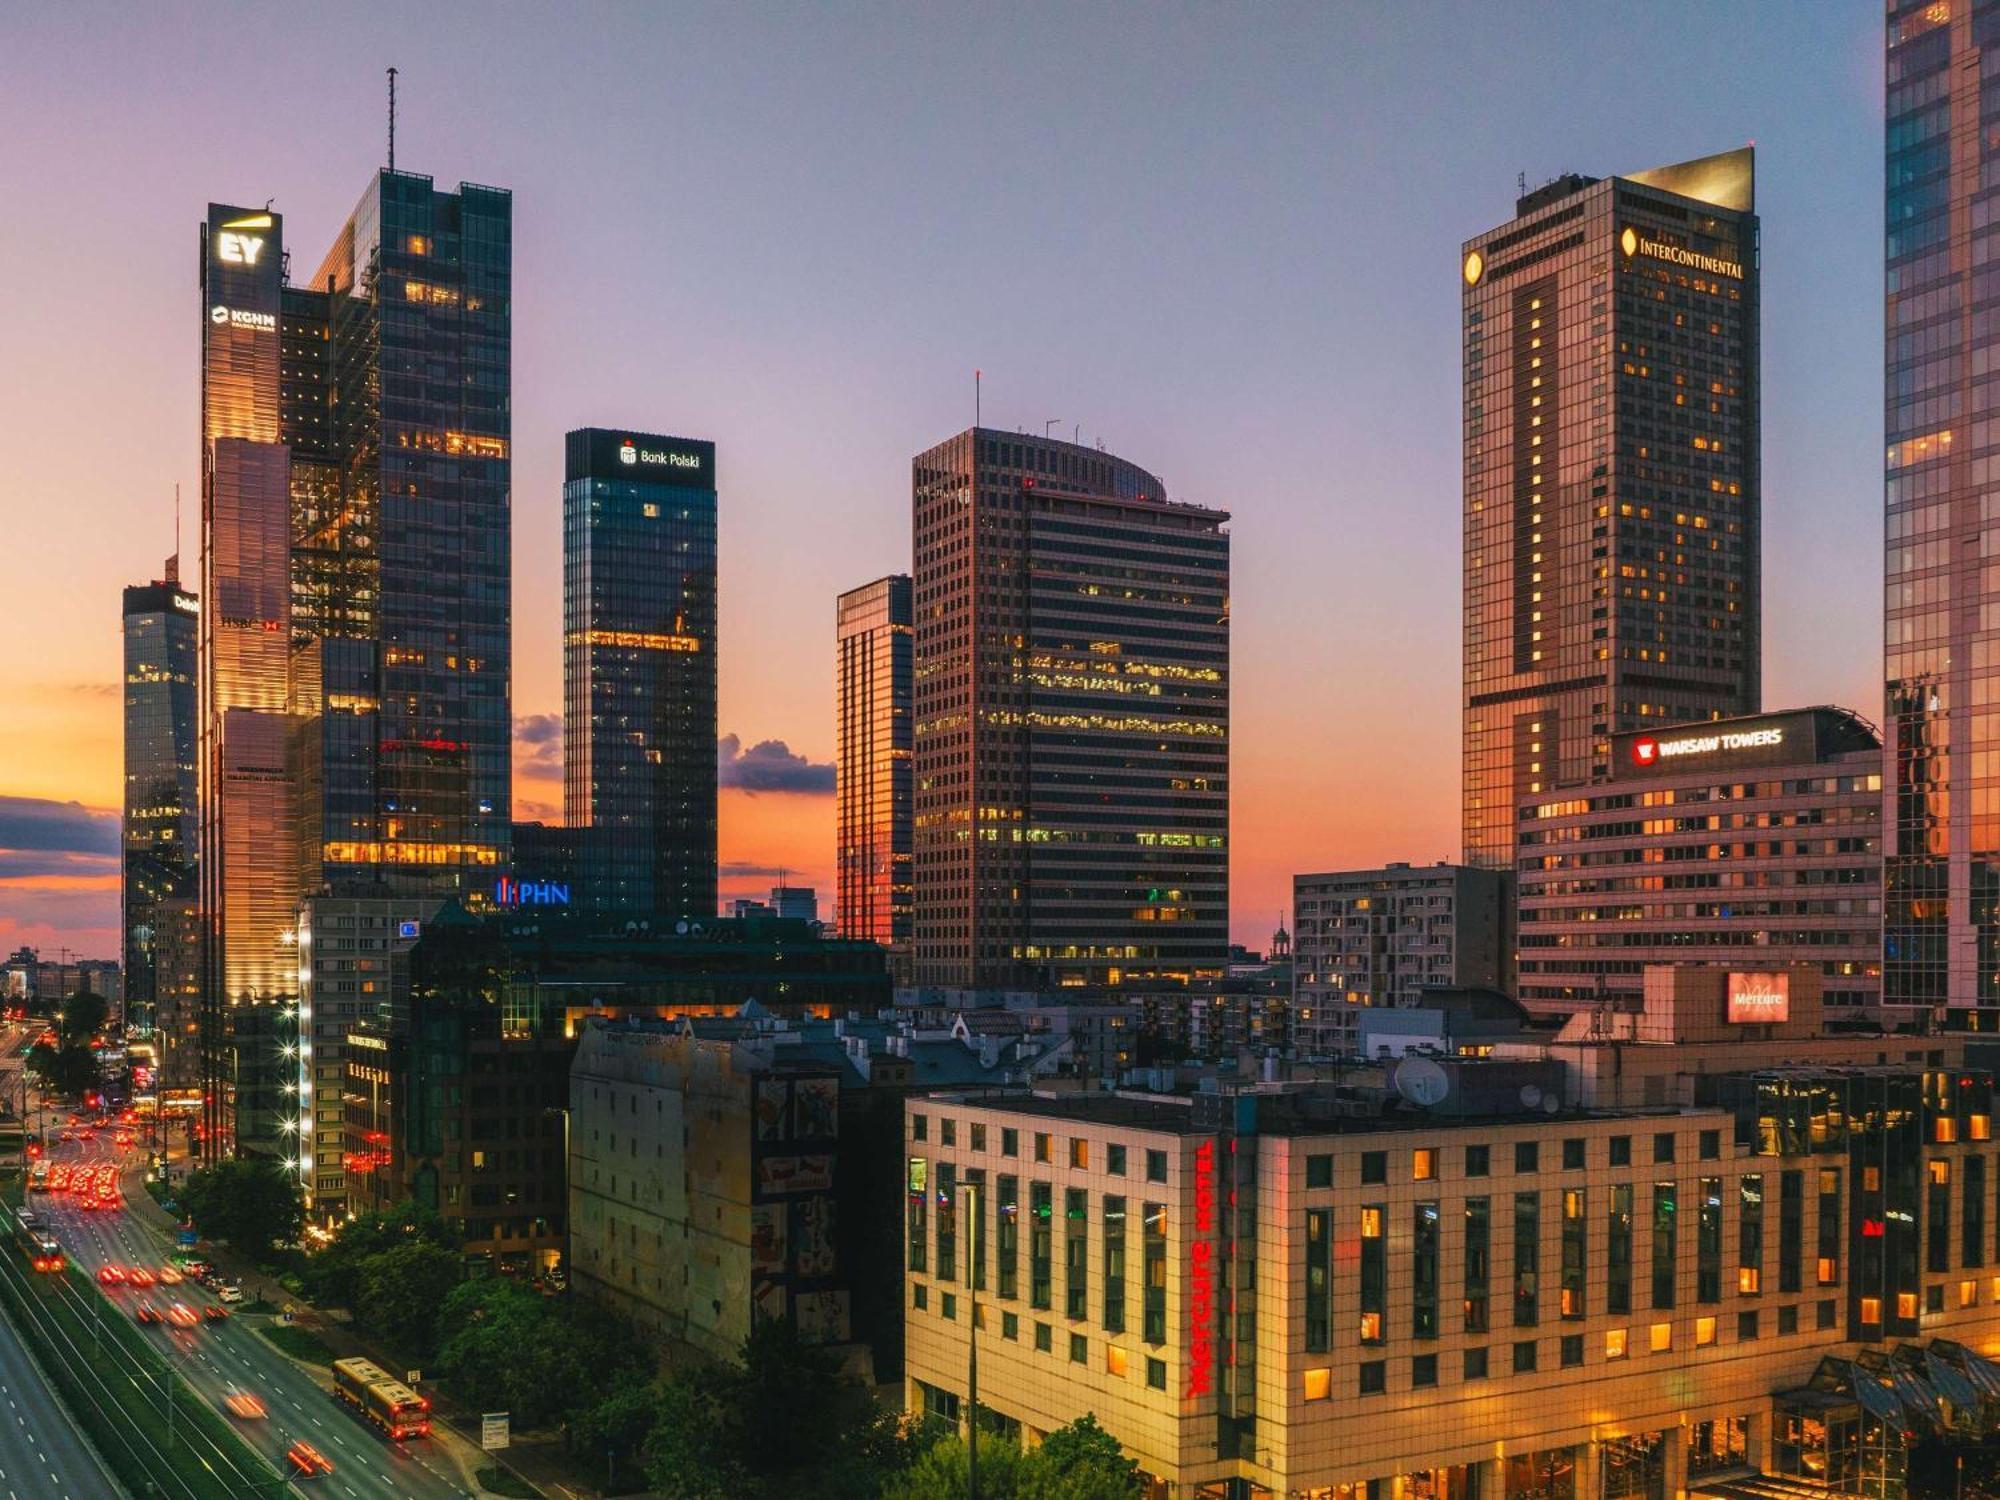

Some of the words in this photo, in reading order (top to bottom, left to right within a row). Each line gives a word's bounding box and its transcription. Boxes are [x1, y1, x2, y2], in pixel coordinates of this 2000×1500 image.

[220, 231, 263, 264] EY
[231, 309, 276, 327] KGHM
[641, 450, 668, 464] Bank
[670, 454, 699, 468] Polski
[222, 617, 259, 629] HSBC
[1659, 736, 1719, 757] WARSAW
[1721, 729, 1782, 749] TOWERS
[521, 883, 569, 904] PHN
[1735, 993, 1782, 1005] Mercure
[1195, 1139, 1214, 1232] HOTEL
